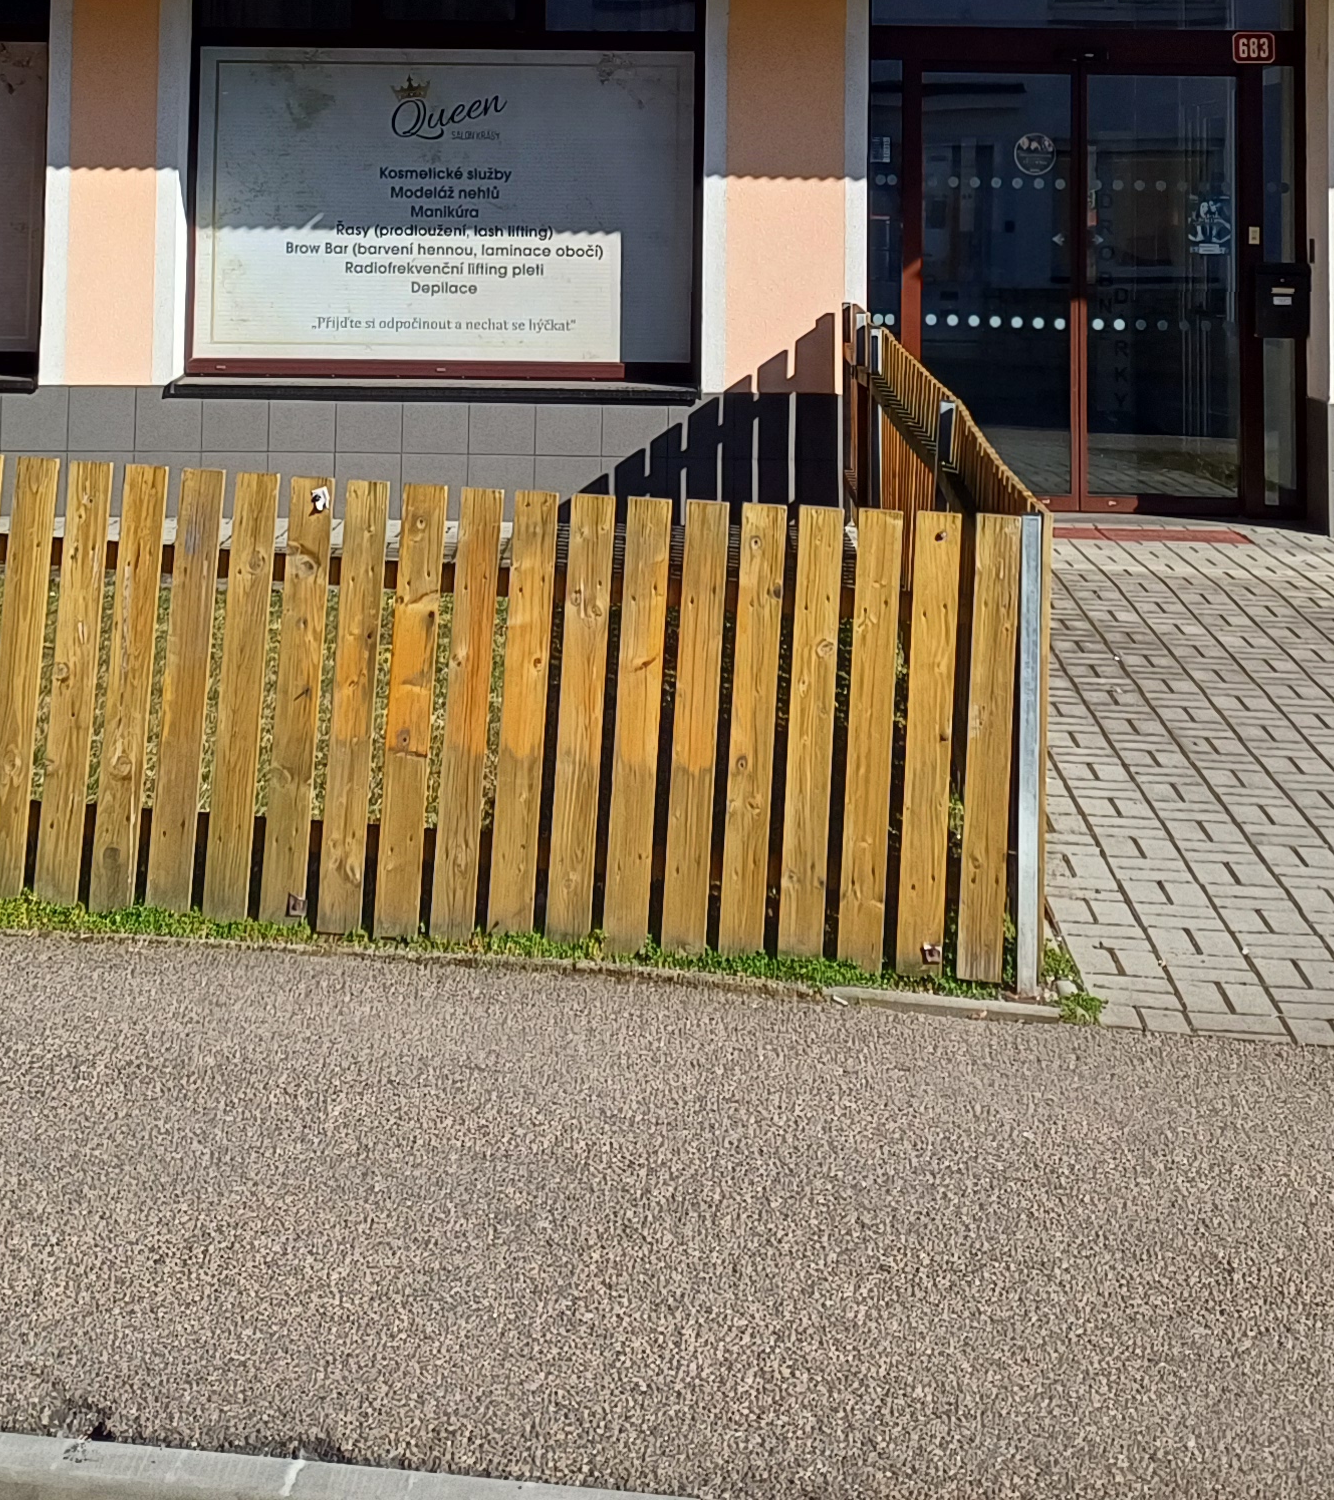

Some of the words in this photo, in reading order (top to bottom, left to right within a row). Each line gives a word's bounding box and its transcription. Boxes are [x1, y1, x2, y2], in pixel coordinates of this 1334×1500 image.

[1239, 37, 1269, 58] 683
[391, 93, 508, 140] Queen
[379, 167, 464, 181] Kosmetické
[466, 167, 512, 184] služby
[390, 185, 455, 200] Modeláž
[458, 184, 500, 200] nehtů
[410, 204, 479, 219] Manikúra
[336, 220, 370, 238] Řasy
[374, 223, 470, 239] (prodloužení,
[473, 225, 504, 238] lash
[507, 225, 554, 241] lifting)
[285, 241, 320, 254] Brow
[325, 242, 349, 255] Bar
[352, 242, 414, 257] (barvení
[418, 243, 478, 258] hennou,
[481, 244, 551, 257] laminace
[555, 244, 604, 260] obočí)
[345, 261, 464, 277] Radiofrekvenční
[467, 262, 508, 279] lifting
[512, 263, 545, 279] pleti
[411, 281, 478, 296] Depilace
[365, 318, 376, 329] si
[378, 316, 452, 333] odpočinout
[454, 320, 463, 330] a
[466, 318, 509, 331] nechat
[511, 320, 526, 331] se
